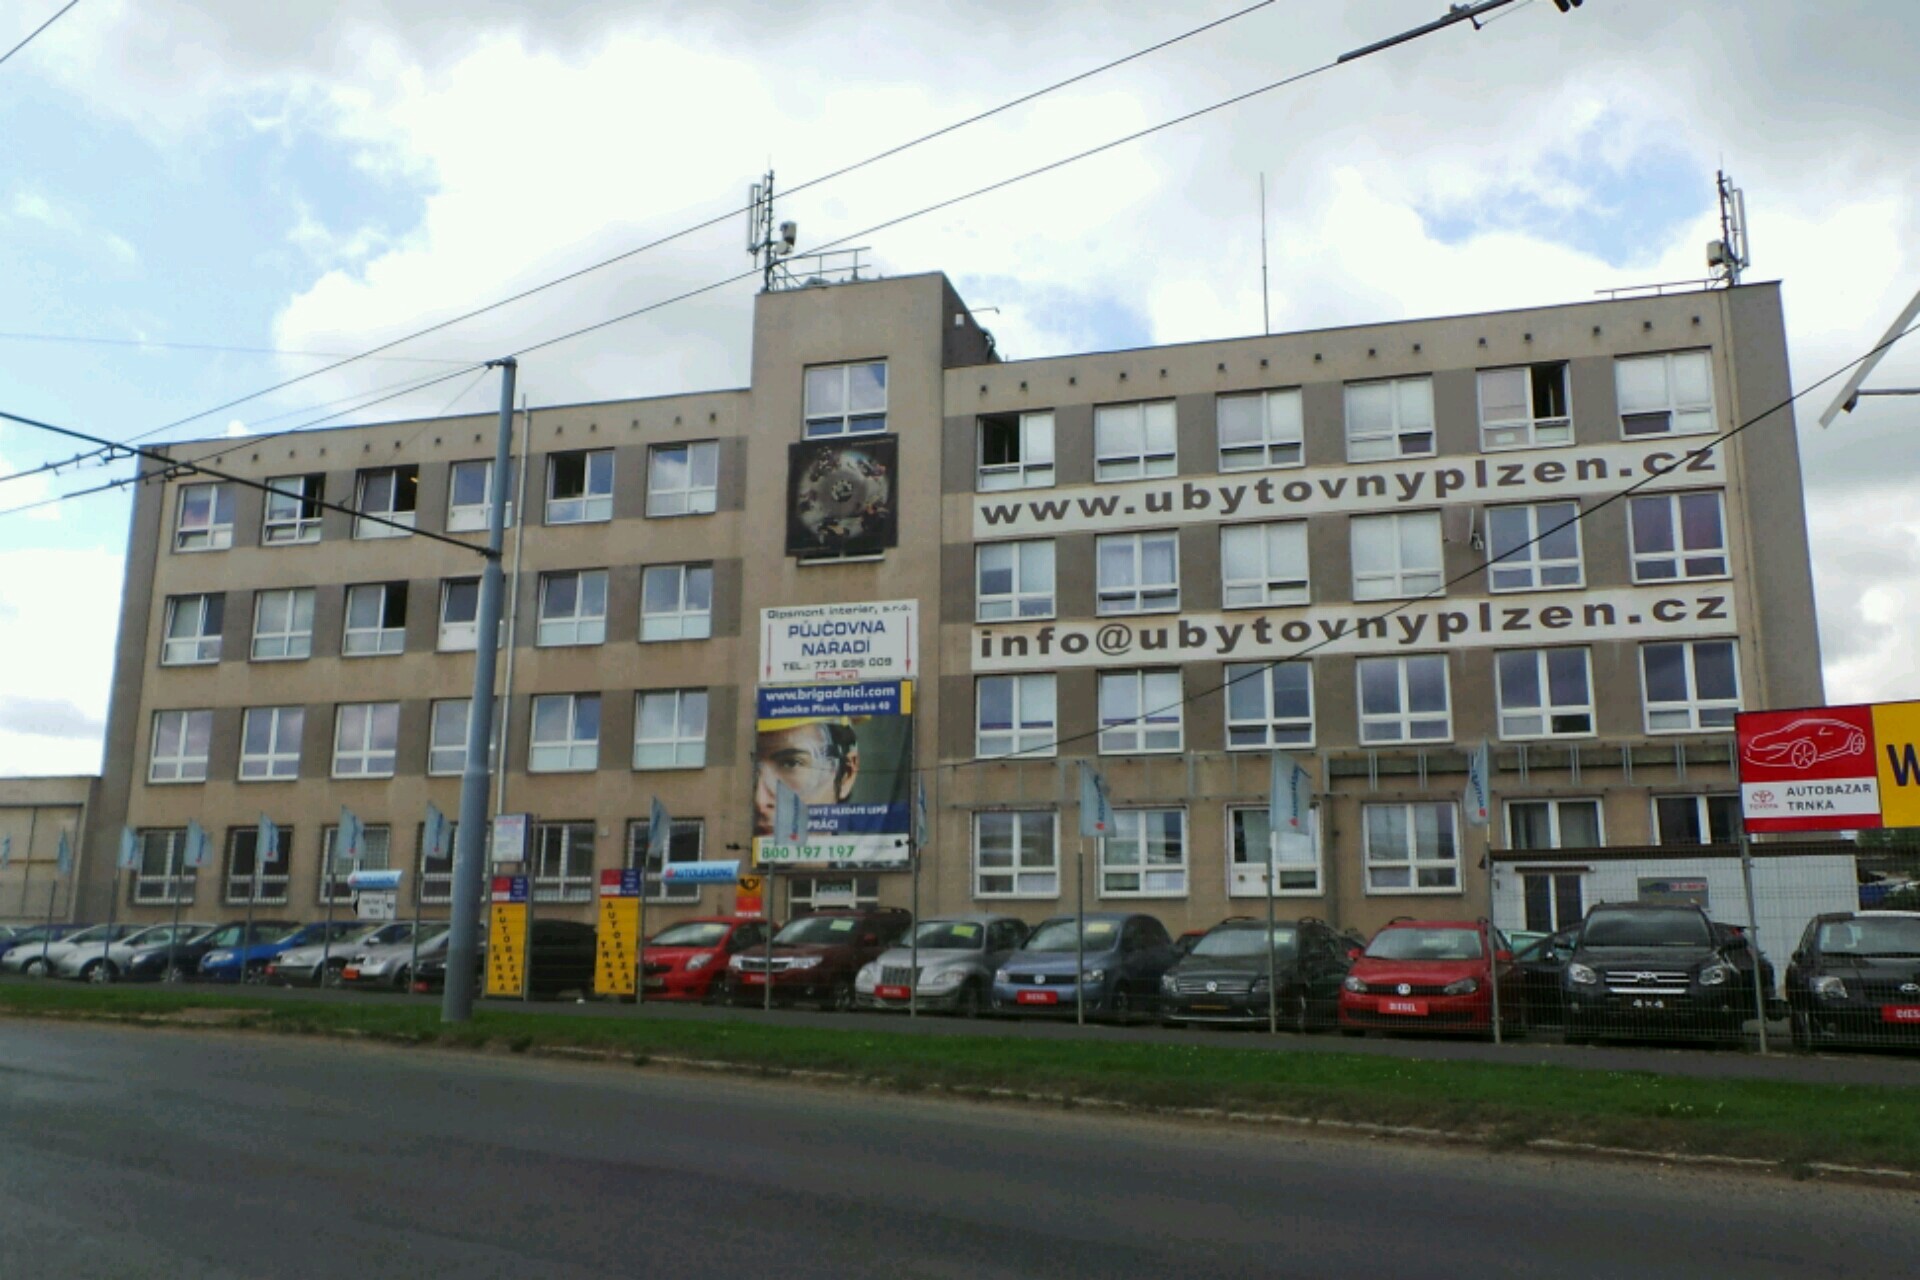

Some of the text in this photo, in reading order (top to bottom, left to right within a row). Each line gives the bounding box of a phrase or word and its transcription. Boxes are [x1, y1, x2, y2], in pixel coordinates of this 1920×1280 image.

[981, 449, 1716, 525] www.ubytovnyplzen.cz
[788, 620, 886, 639] PŮJČOVNA
[980, 596, 1728, 658] info@ubytovnyplzen.cz
[801, 636, 871, 656] NÁŘADÍ
[814, 660, 837, 669] 773
[765, 685, 896, 702] www.brigadnici.com
[1786, 783, 1872, 797] AUTOBAZAR
[1787, 800, 1835, 811] TRNKA
[762, 845, 856, 859] 800 197 197
